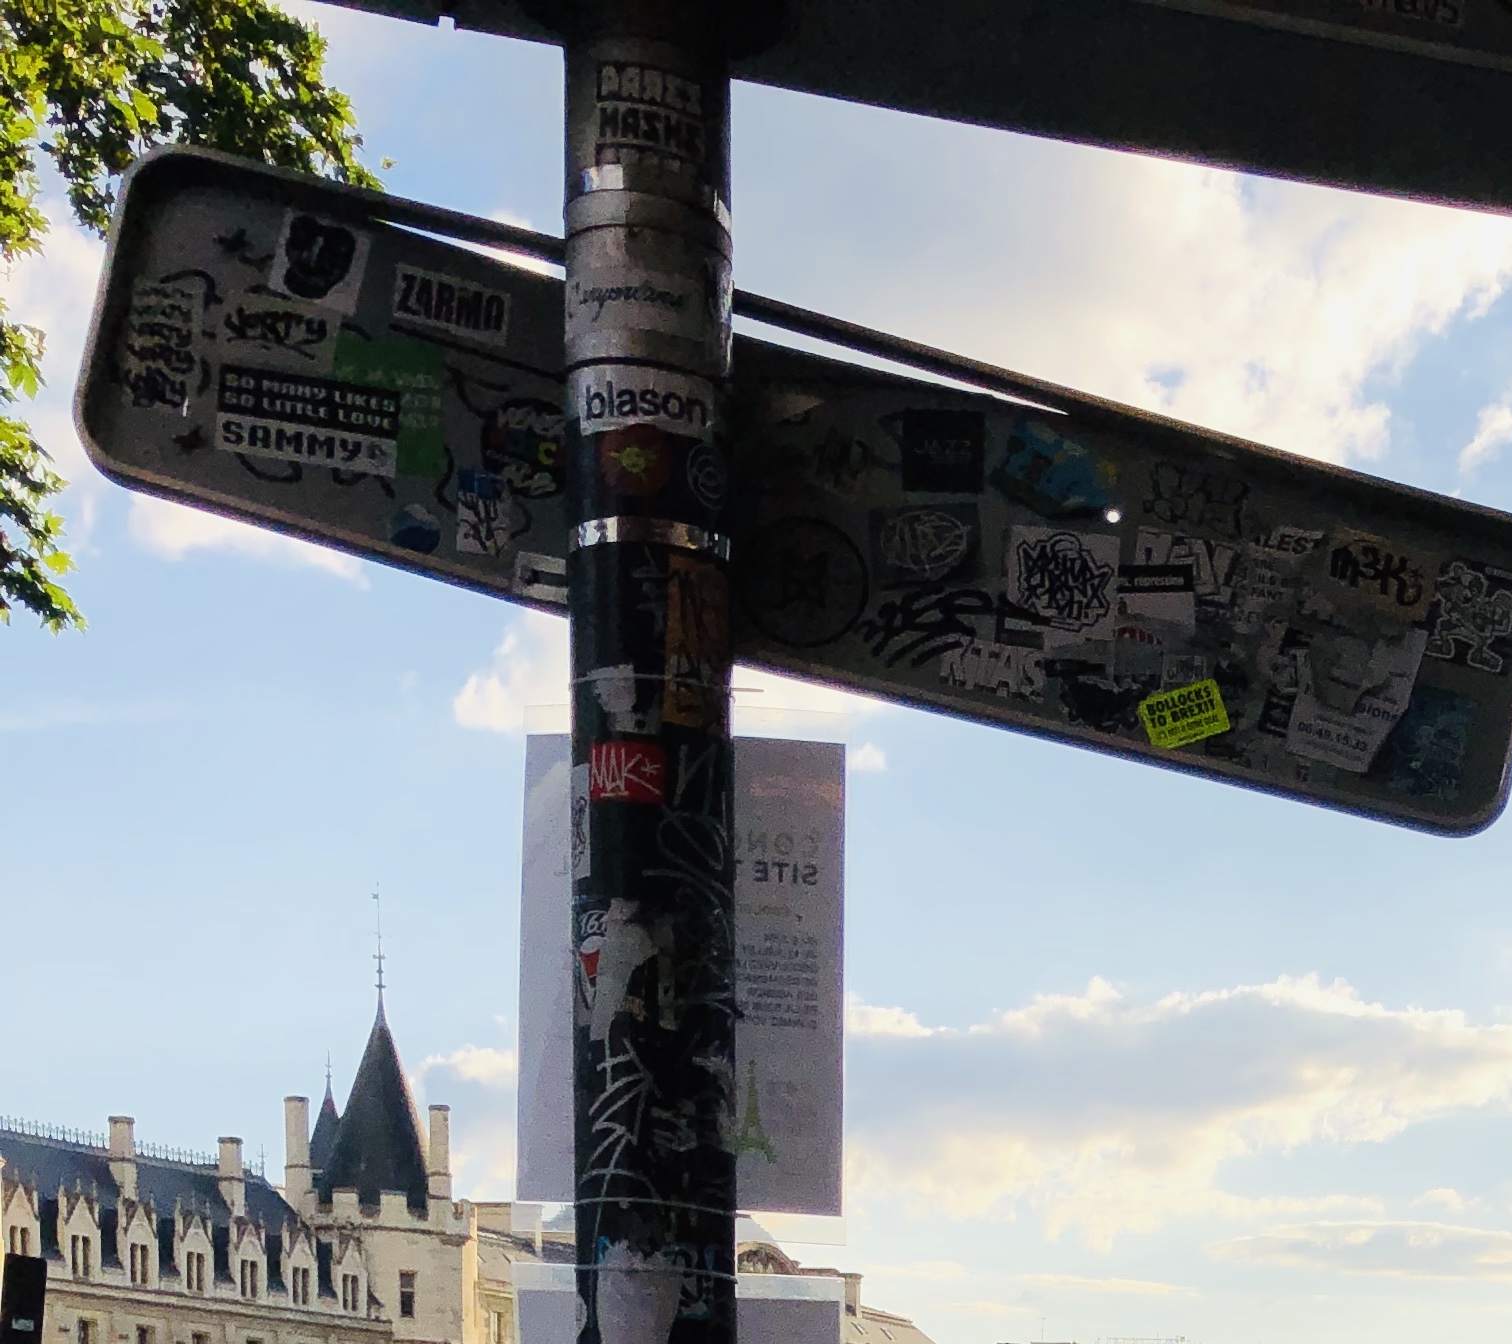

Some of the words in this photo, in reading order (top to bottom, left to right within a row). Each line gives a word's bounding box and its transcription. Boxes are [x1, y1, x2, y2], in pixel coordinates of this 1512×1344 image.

[224, 391, 255, 408] SO
[263, 397, 330, 419] LITTLE
[337, 408, 393, 430] LOVE
[225, 373, 255, 388] SO
[262, 379, 326, 399] MANY
[334, 390, 396, 412] LIKES
[585, 380, 708, 428] blason
[222, 420, 362, 461] SAMMY
[913, 439, 972, 455] JAZZ
[1146, 685, 1211, 716] BOLLOCKS
[1149, 714, 1167, 728] TO
[1170, 699, 1216, 722] BREXIT
